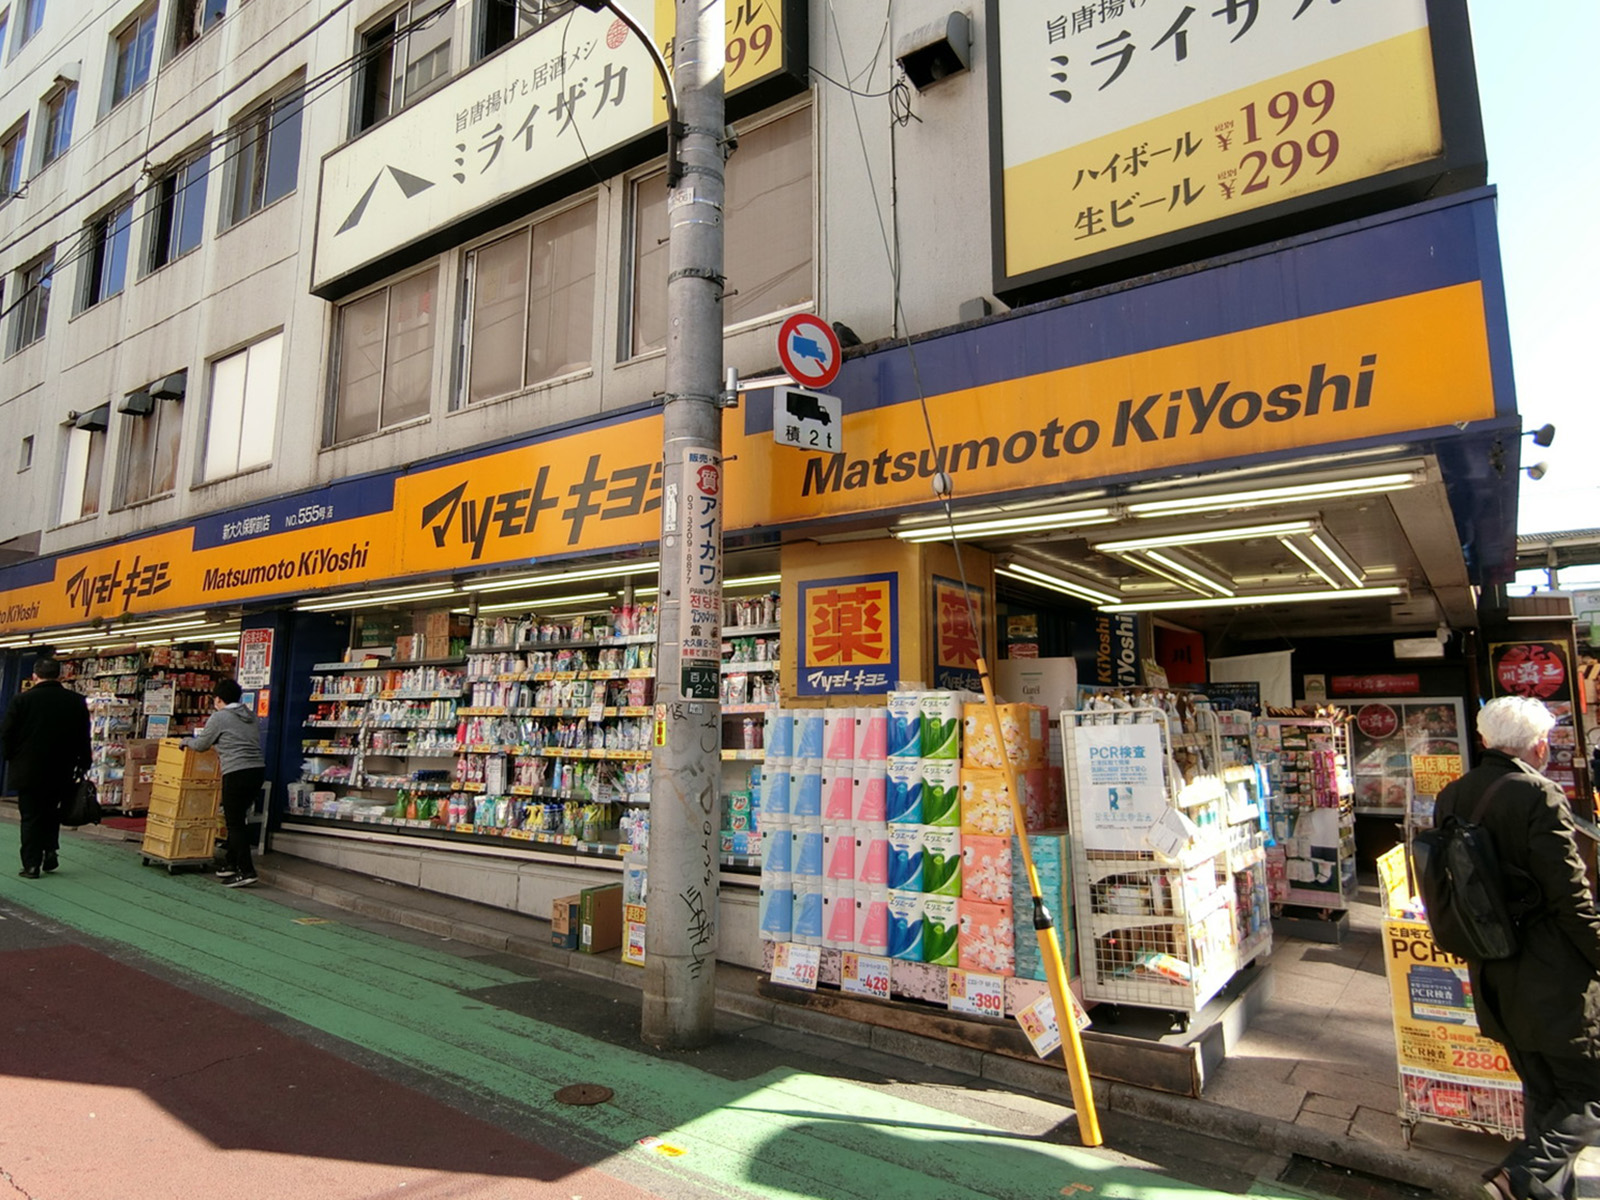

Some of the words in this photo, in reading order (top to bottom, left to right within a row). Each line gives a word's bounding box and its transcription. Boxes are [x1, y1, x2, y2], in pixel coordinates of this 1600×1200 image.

[1046, 0, 1145, 44] 旨唐揚
[725, 24, 773, 78] 99
[1049, 0, 1345, 104] ミライ
[456, 39, 598, 134] 旨唐揚げと居酒メシ
[452, 62, 628, 184] ミライザカ
[1072, 131, 1203, 191] ハイボール
[1074, 176, 1206, 241] 生ビール
[801, 416, 1101, 497] Matsumoto
[1112, 354, 1377, 448] KiYoshi
[222, 514, 271, 540] 新大久保駅前店
[700, 496, 717, 585] アイカワ
[65, 555, 172, 618] マツモトキヨシ
[202, 559, 295, 592] Matsumoto
[296, 541, 370, 577] KiYoshi
[6, 601, 40, 624] KiYoshi
[812, 586, 884, 663] 薬
[941, 592, 981, 665] 薬
[694, 684, 715, 695] 2-4
[807, 669, 889, 693] マツモトキヨシ
[1090, 746, 1146, 759] PCR検査
[1412, 757, 1461, 773] 当店限定
[794, 963, 817, 979] 278
[866, 975, 888, 991] 428
[975, 993, 1001, 1010] 380
[1411, 987, 1453, 1001] PCR検査
[1403, 1046, 1447, 1060] PCR検査
[1452, 1050, 1509, 1072] 2880
